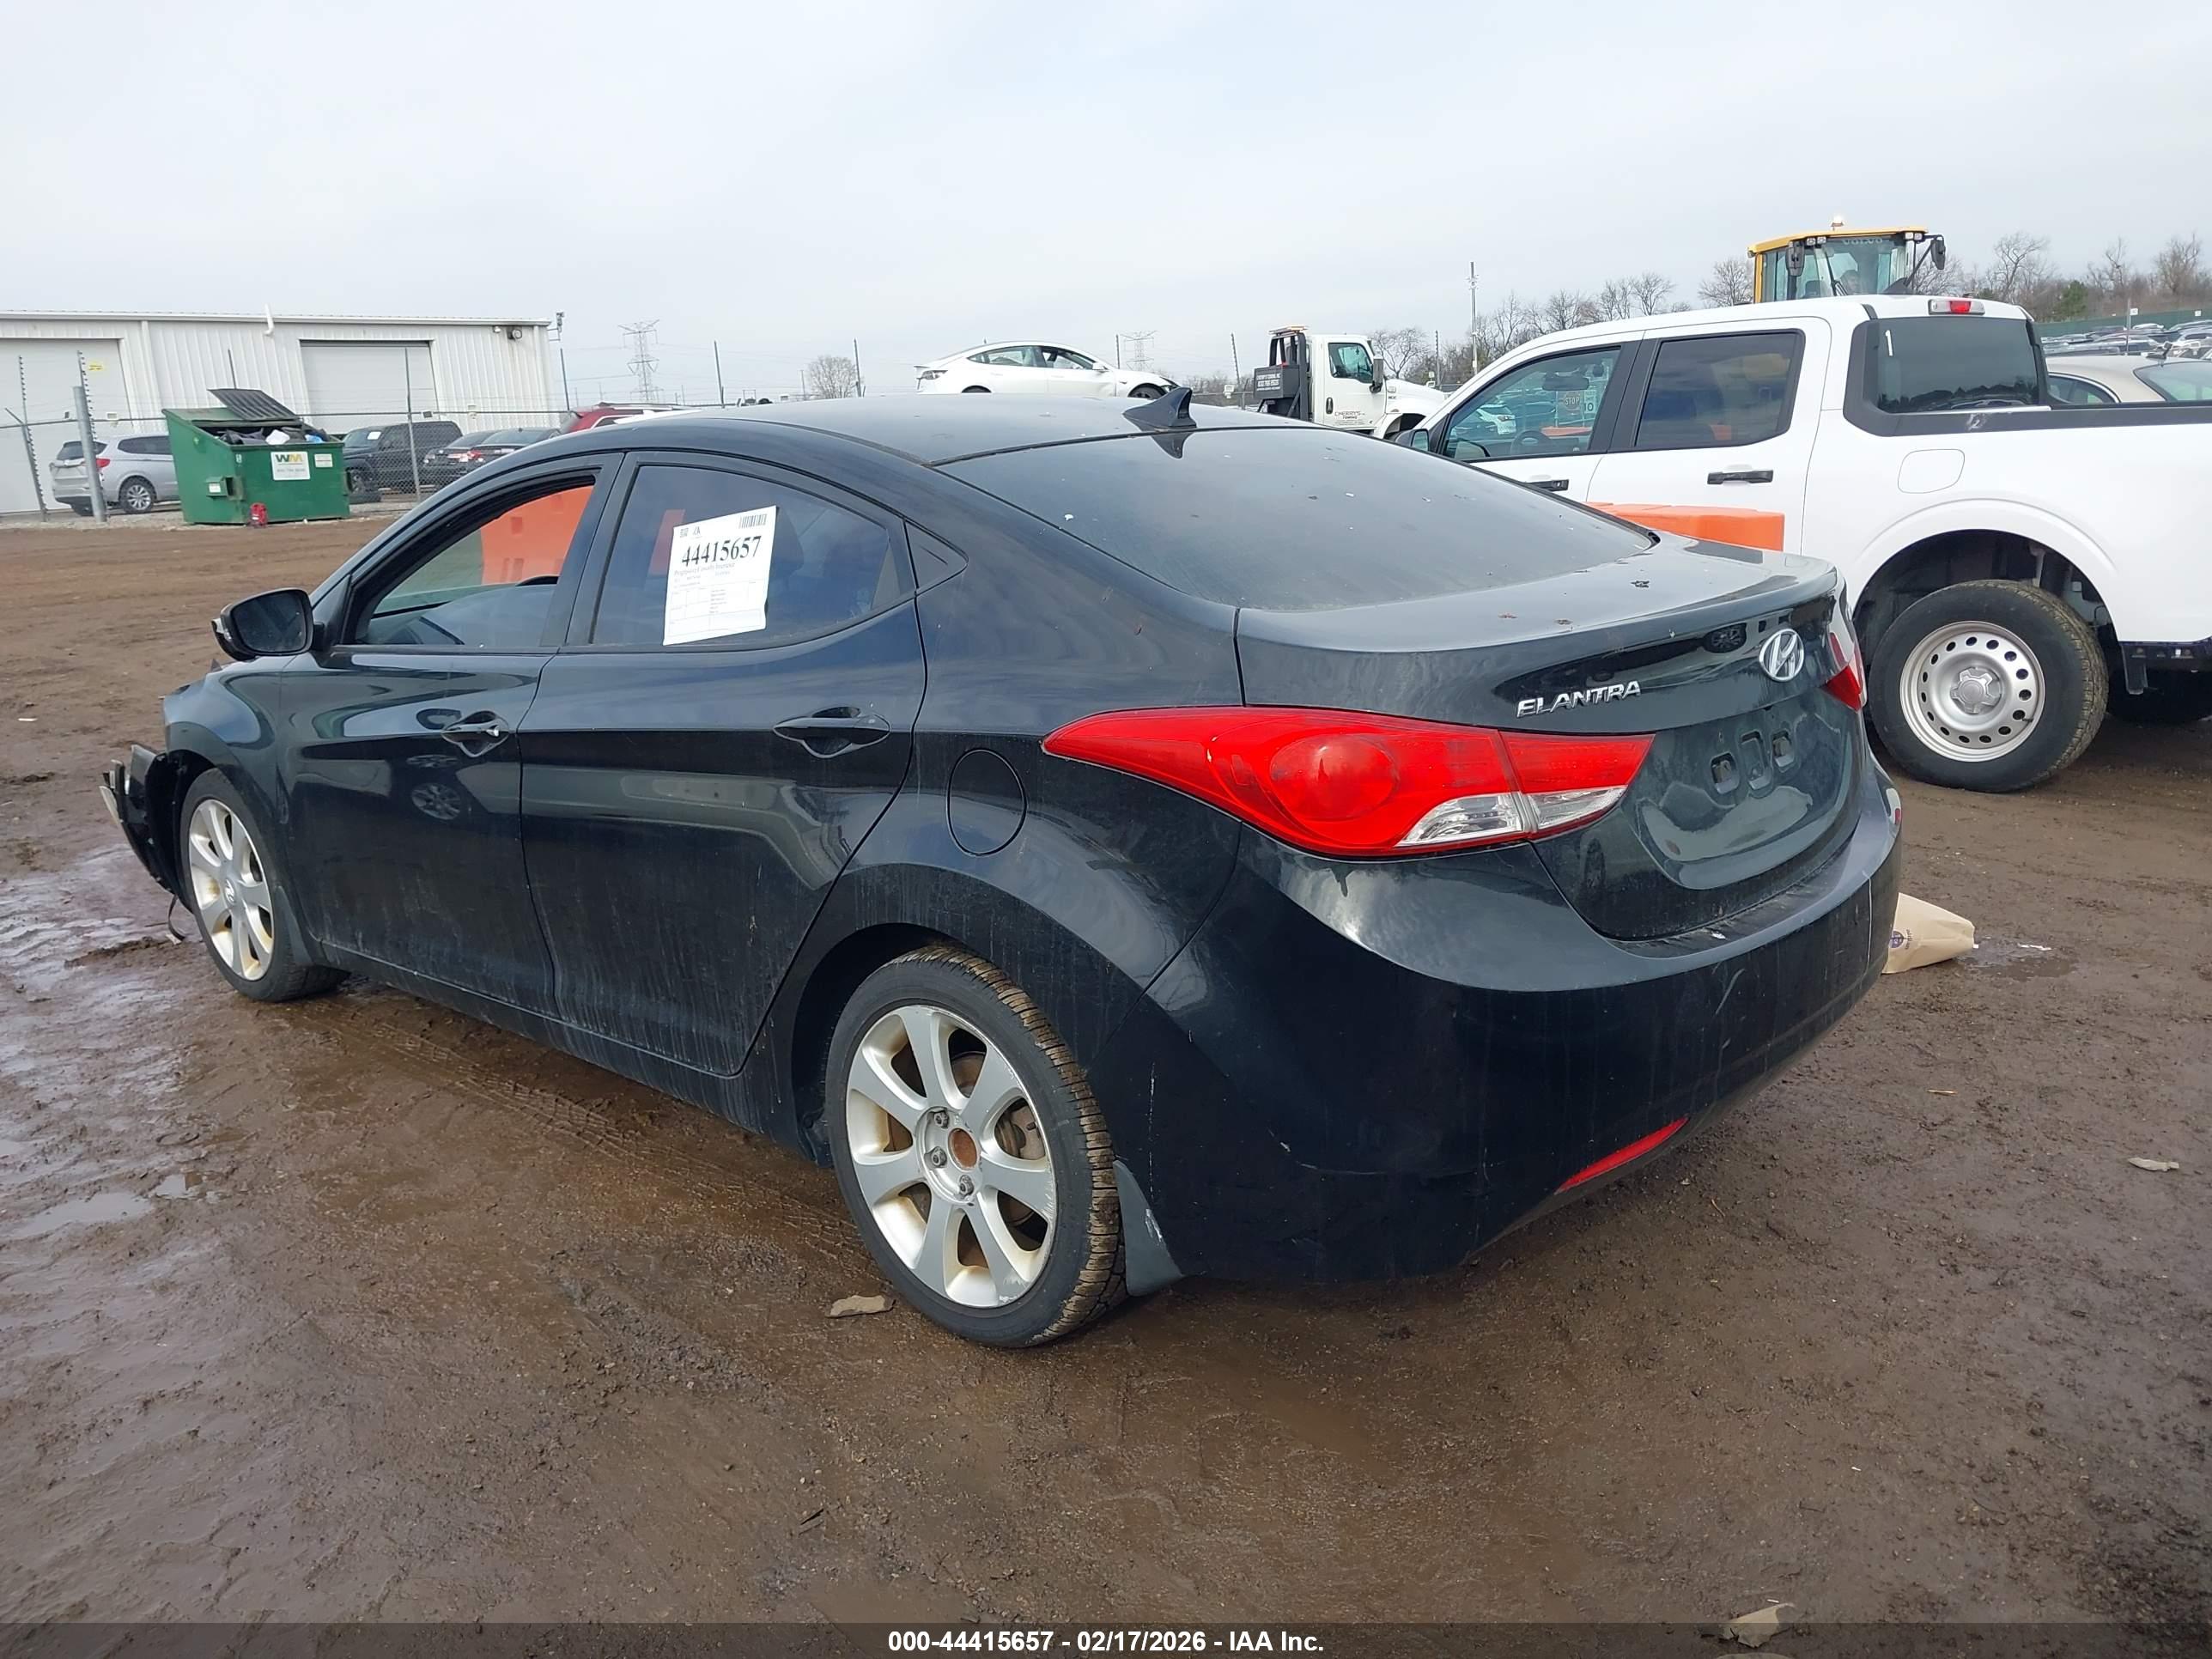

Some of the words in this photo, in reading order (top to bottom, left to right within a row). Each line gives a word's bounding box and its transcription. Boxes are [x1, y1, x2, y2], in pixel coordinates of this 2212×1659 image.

[1565, 396, 1580, 405] STOP
[275, 453, 302, 463] WM
[681, 535, 762, 568] 44415657
[1516, 680, 1642, 718] ELANTRA
